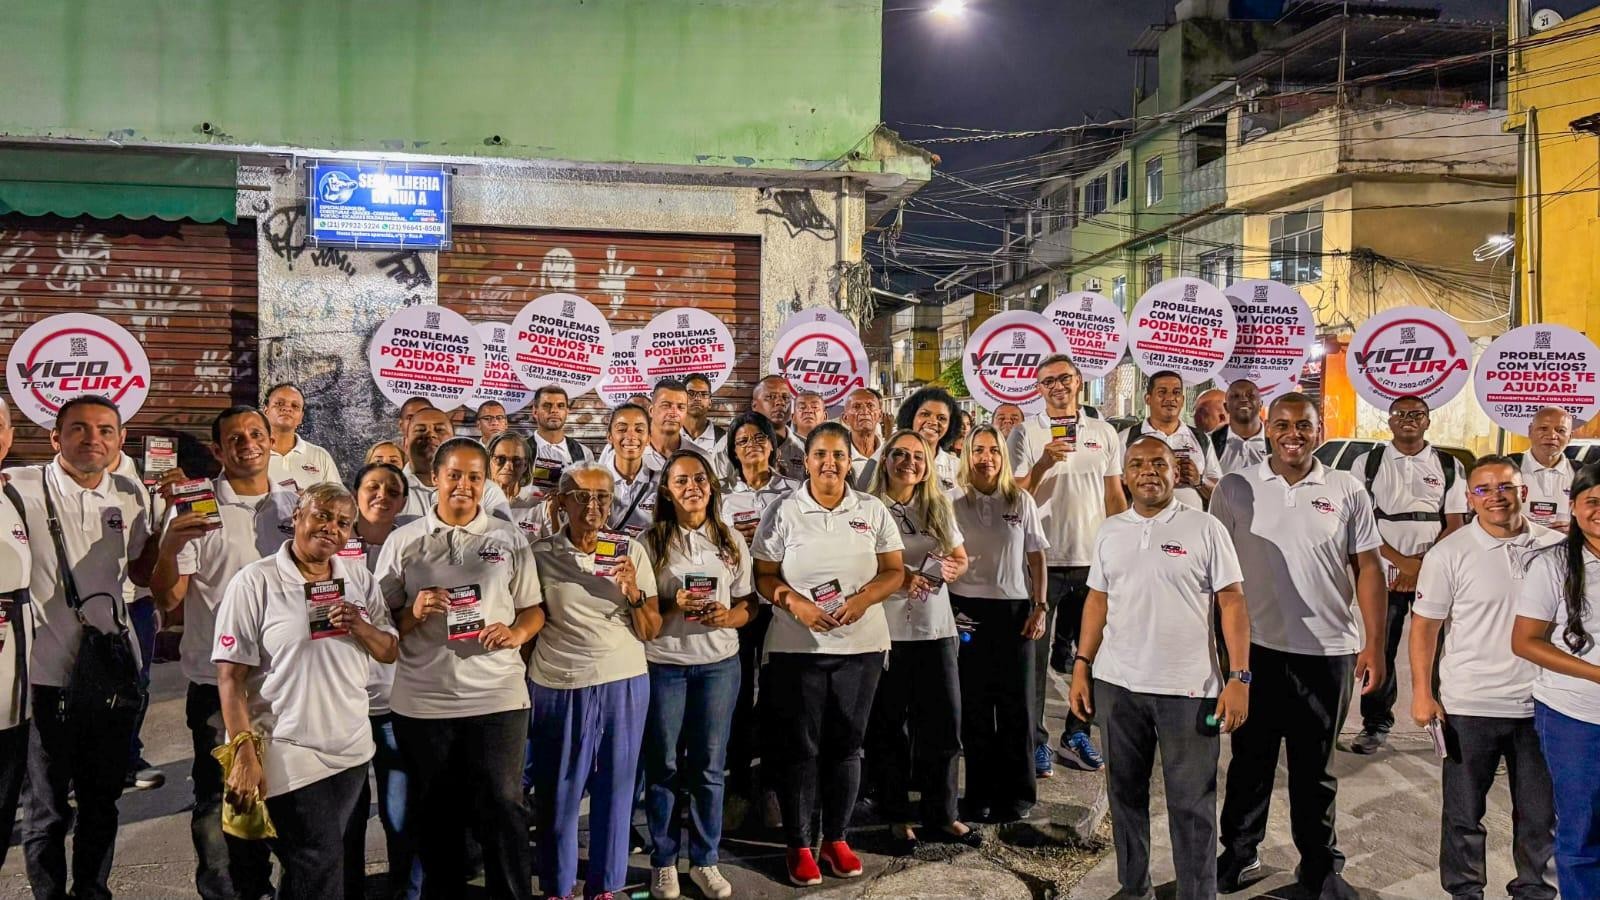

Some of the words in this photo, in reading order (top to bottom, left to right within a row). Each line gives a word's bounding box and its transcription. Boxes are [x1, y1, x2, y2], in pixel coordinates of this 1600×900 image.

[419, 192, 426, 204] A
[1153, 300, 1223, 317] PROBLEMAS
[1232, 305, 1298, 314] ROBLEMAS
[1055, 310, 1115, 324] PROBLEMAS
[1150, 311, 1175, 321] COM
[1180, 314, 1223, 328] VÍCIOS?
[1251, 314, 1299, 324] VÍCIOS?
[532, 314, 600, 334] PROBLEMAS
[1078, 321, 1115, 332] VÍCIOS?
[1139, 318, 1208, 336] PODEMOS
[1212, 328, 1228, 339] TE
[1288, 326, 1305, 335] TE
[394, 328, 469, 344] PROBLEMAS
[529, 324, 554, 335] COM
[558, 328, 600, 343] VÍCIOS?
[653, 328, 716, 339] PROBLEMAS
[1061, 327, 1102, 339] DEMOS
[1106, 333, 1119, 342] TE
[1152, 332, 1212, 348] AJUDAR!
[391, 338, 418, 348] COM
[424, 341, 469, 354] VÍCIOS?
[518, 331, 585, 351] PODEMOS
[590, 344, 605, 355] TE
[678, 337, 717, 346] VÍCIOS?
[1069, 338, 1106, 349] UDAR!
[1236, 336, 1289, 345] JUDAR!
[381, 346, 455, 363] PODEMOS
[459, 355, 476, 365] TE
[530, 345, 589, 362] AJUDAR!
[645, 345, 706, 357] PODEMOS
[711, 344, 725, 352] TE
[1354, 347, 1434, 364] VÍCIO
[1500, 352, 1586, 360] PROBLEMAS
[659, 354, 712, 365] AJUDAR!
[971, 351, 1041, 366] VÍCIO
[1073, 356, 1108, 366] 582-0557
[1147, 361, 1180, 369] TOTALMENTE
[1150, 353, 1165, 362] (21)
[1168, 356, 1214, 368] 2582-0557
[16, 360, 109, 378] VÍCIO
[395, 359, 460, 374] AJUDAR!
[777, 357, 841, 374] VÍCIO
[1389, 359, 1468, 374] CURA
[1497, 362, 1529, 370] COM
[1532, 361, 1587, 371] VÍCIOS?
[529, 365, 544, 375] (21)
[546, 368, 592, 382] 2582-0557
[1000, 367, 1039, 378] CU
[1486, 371, 1571, 381] PODEMOS
[1575, 373, 1595, 382] TE
[59, 375, 145, 391] CURA
[803, 373, 864, 387] CURA
[1382, 379, 1397, 388] (21)
[1398, 375, 1435, 389] 2582-0557
[392, 389, 428, 397] TOTALMENTE
[395, 381, 411, 390] (21)
[414, 383, 464, 394] 2582-0557
[484, 388, 526, 398] 2582-0557
[994, 383, 1006, 391] (21)
[1503, 382, 1577, 393] AJUDAR!
[1504, 404, 1522, 413] (21)
[311, 584, 338, 593] INTENSIVO
